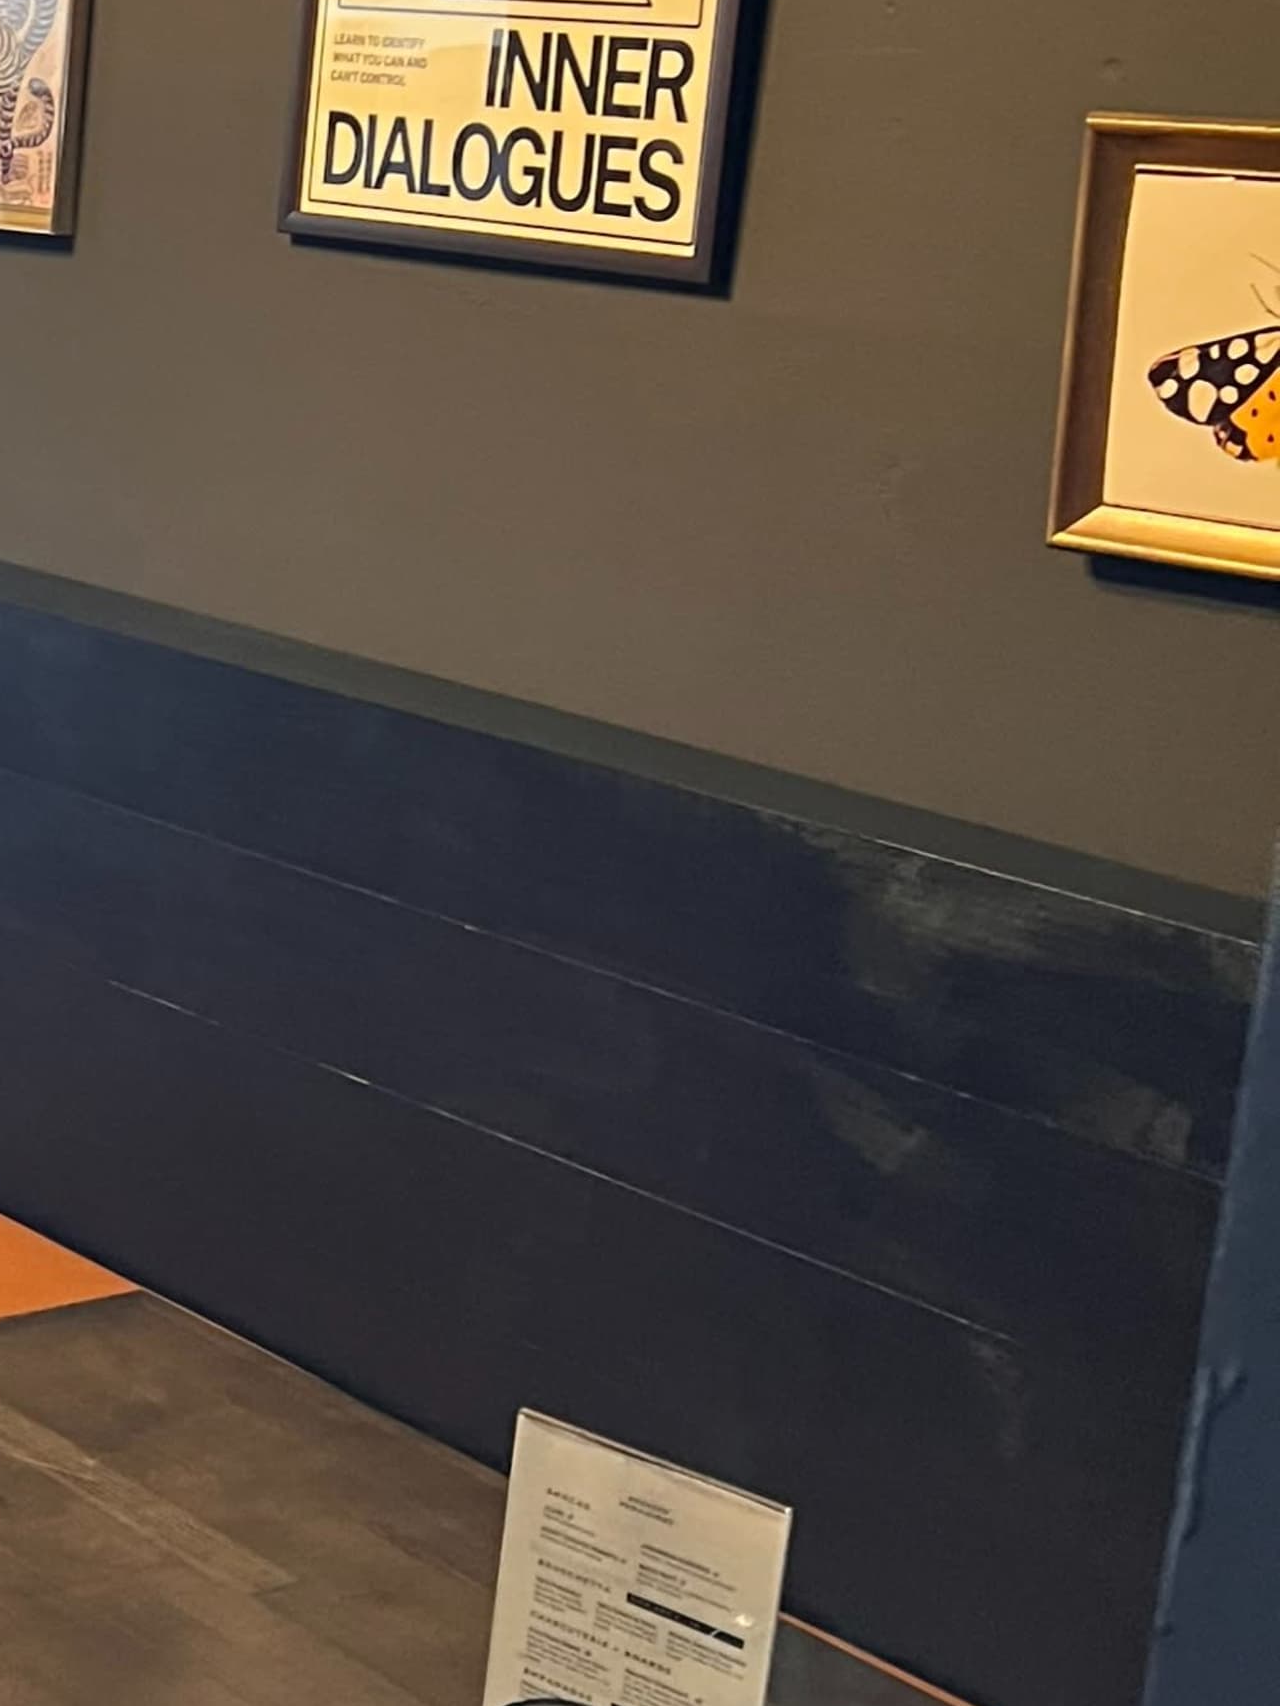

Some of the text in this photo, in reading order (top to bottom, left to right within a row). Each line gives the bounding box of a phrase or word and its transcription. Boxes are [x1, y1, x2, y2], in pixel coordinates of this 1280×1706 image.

[333, 33, 365, 46] LEARN
[368, 34, 380, 47] TO
[333, 52, 361, 63] WHAT
[363, 53, 382, 66] YOU
[384, 55, 405, 68] CAN
[486, 28, 695, 123] INNER
[323, 110, 685, 223] DIALOGUES
